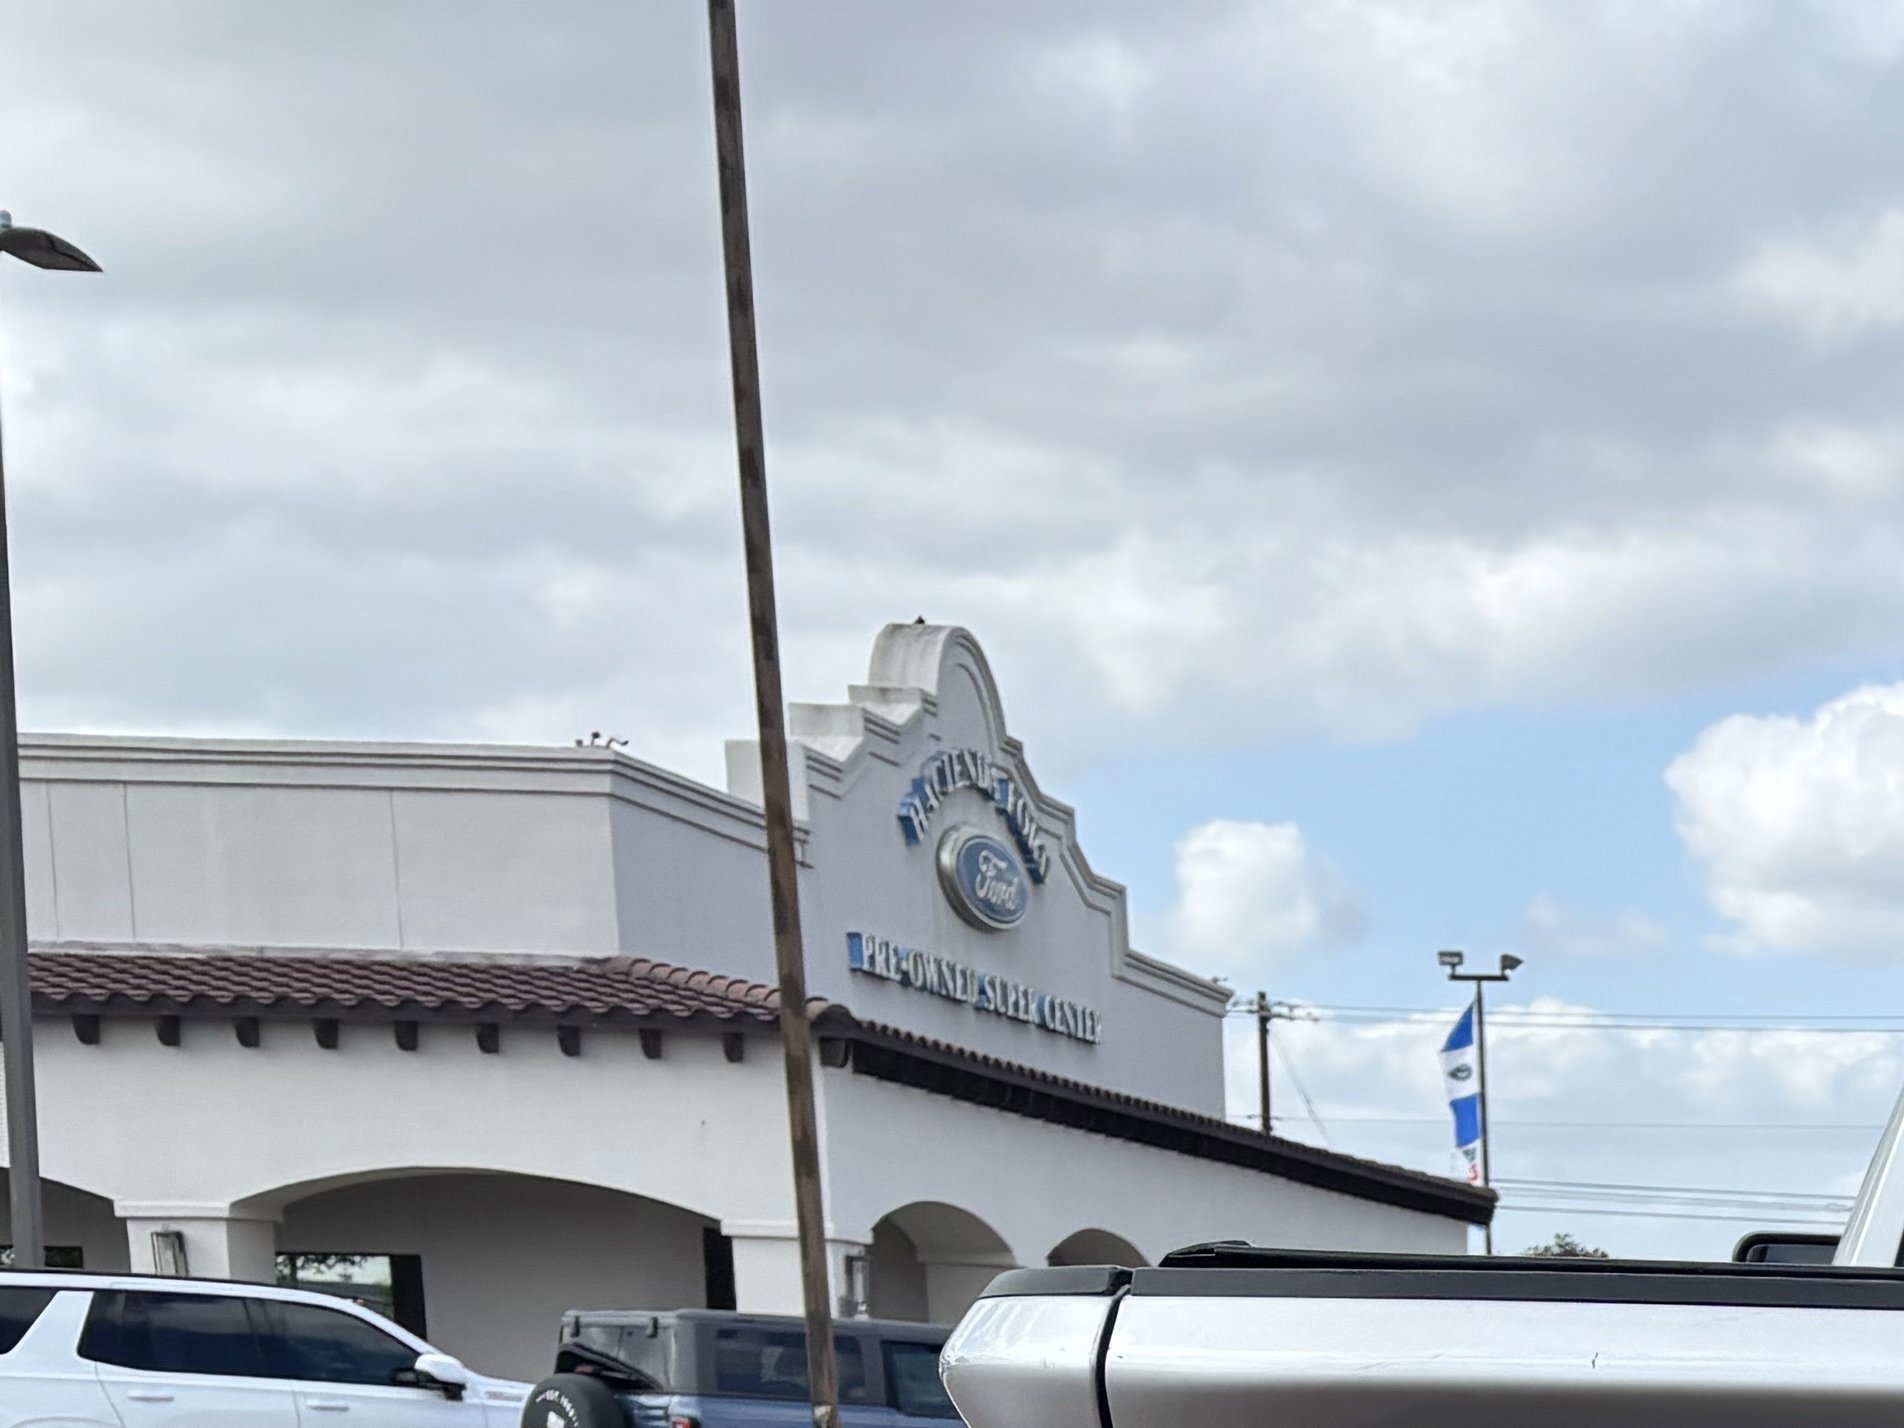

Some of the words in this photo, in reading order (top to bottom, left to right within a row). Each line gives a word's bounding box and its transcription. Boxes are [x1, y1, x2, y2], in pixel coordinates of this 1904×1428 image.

[975, 849, 1019, 911] Ford
[858, 932, 979, 1003] PRE-OWNED
[982, 974, 1041, 1027] SUPER
[1043, 993, 1102, 1044] CENTER
